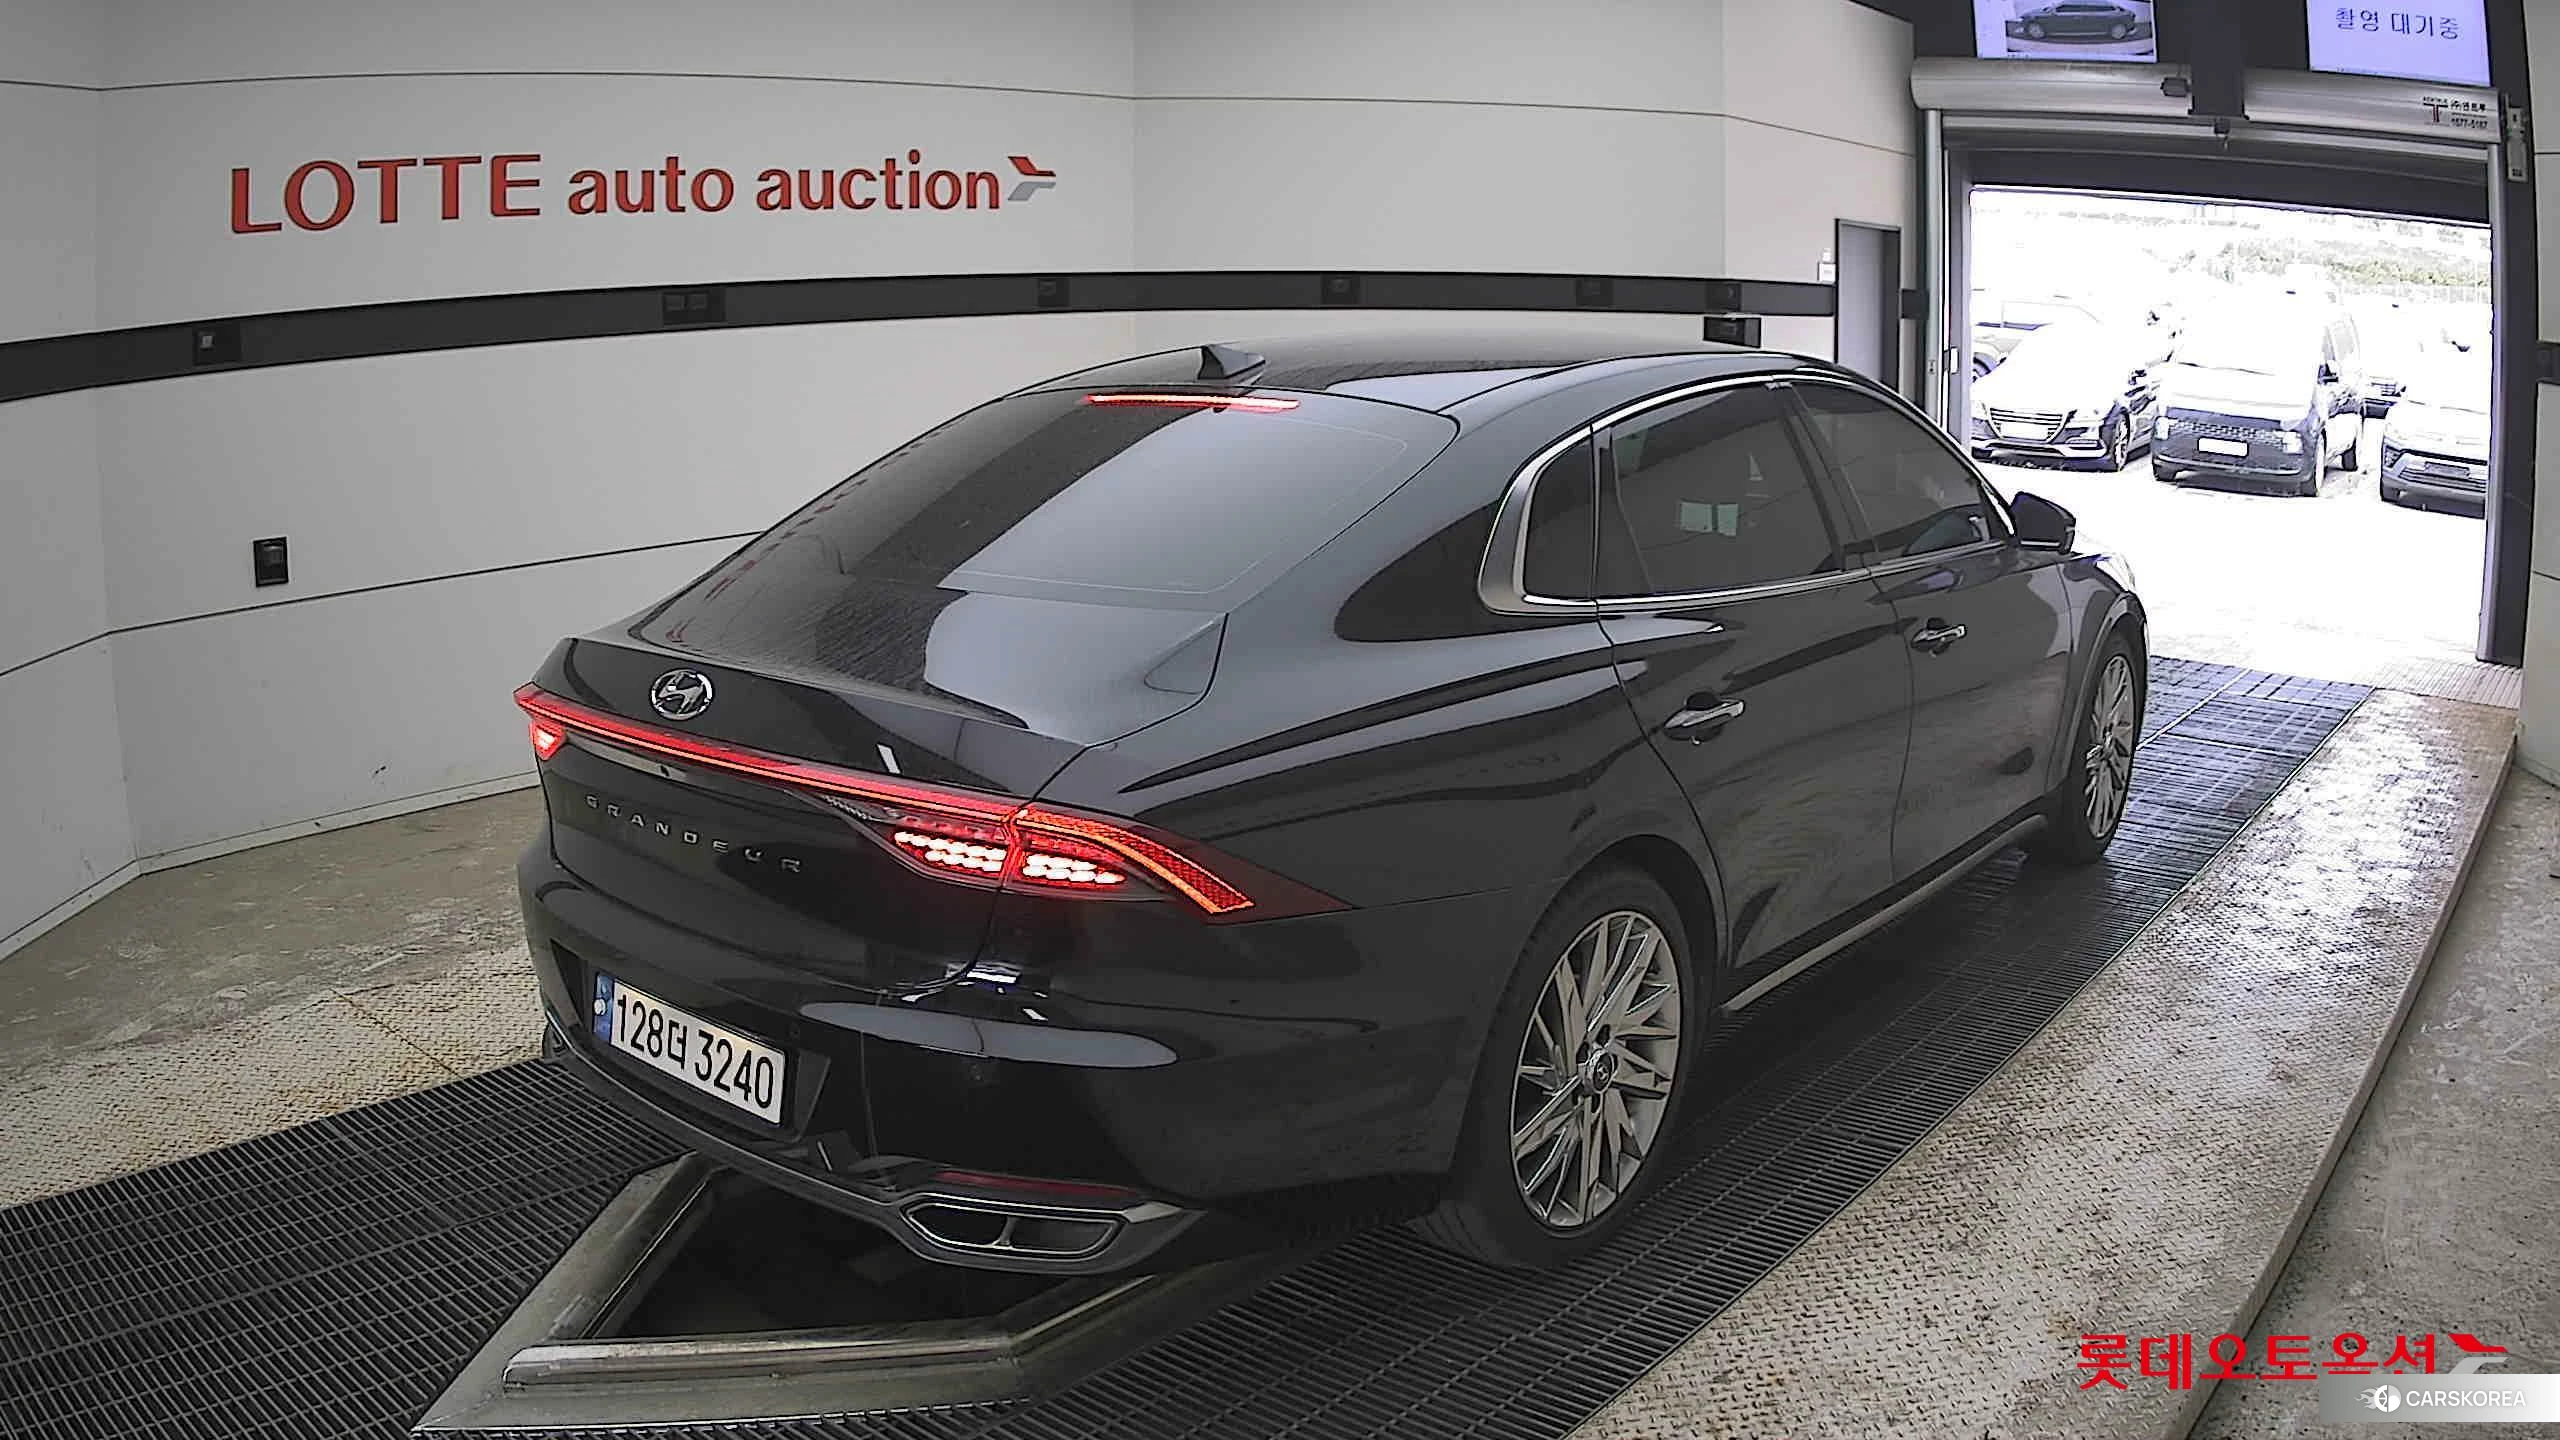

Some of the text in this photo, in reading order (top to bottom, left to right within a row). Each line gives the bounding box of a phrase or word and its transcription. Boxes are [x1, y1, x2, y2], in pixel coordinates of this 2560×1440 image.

[2336, 8, 2458, 40] 촬영 대기중
[231, 148, 1000, 234] LOTTE auto auction
[585, 795, 801, 873] GRANDEUR
[617, 994, 773, 1109] 128더 3240
